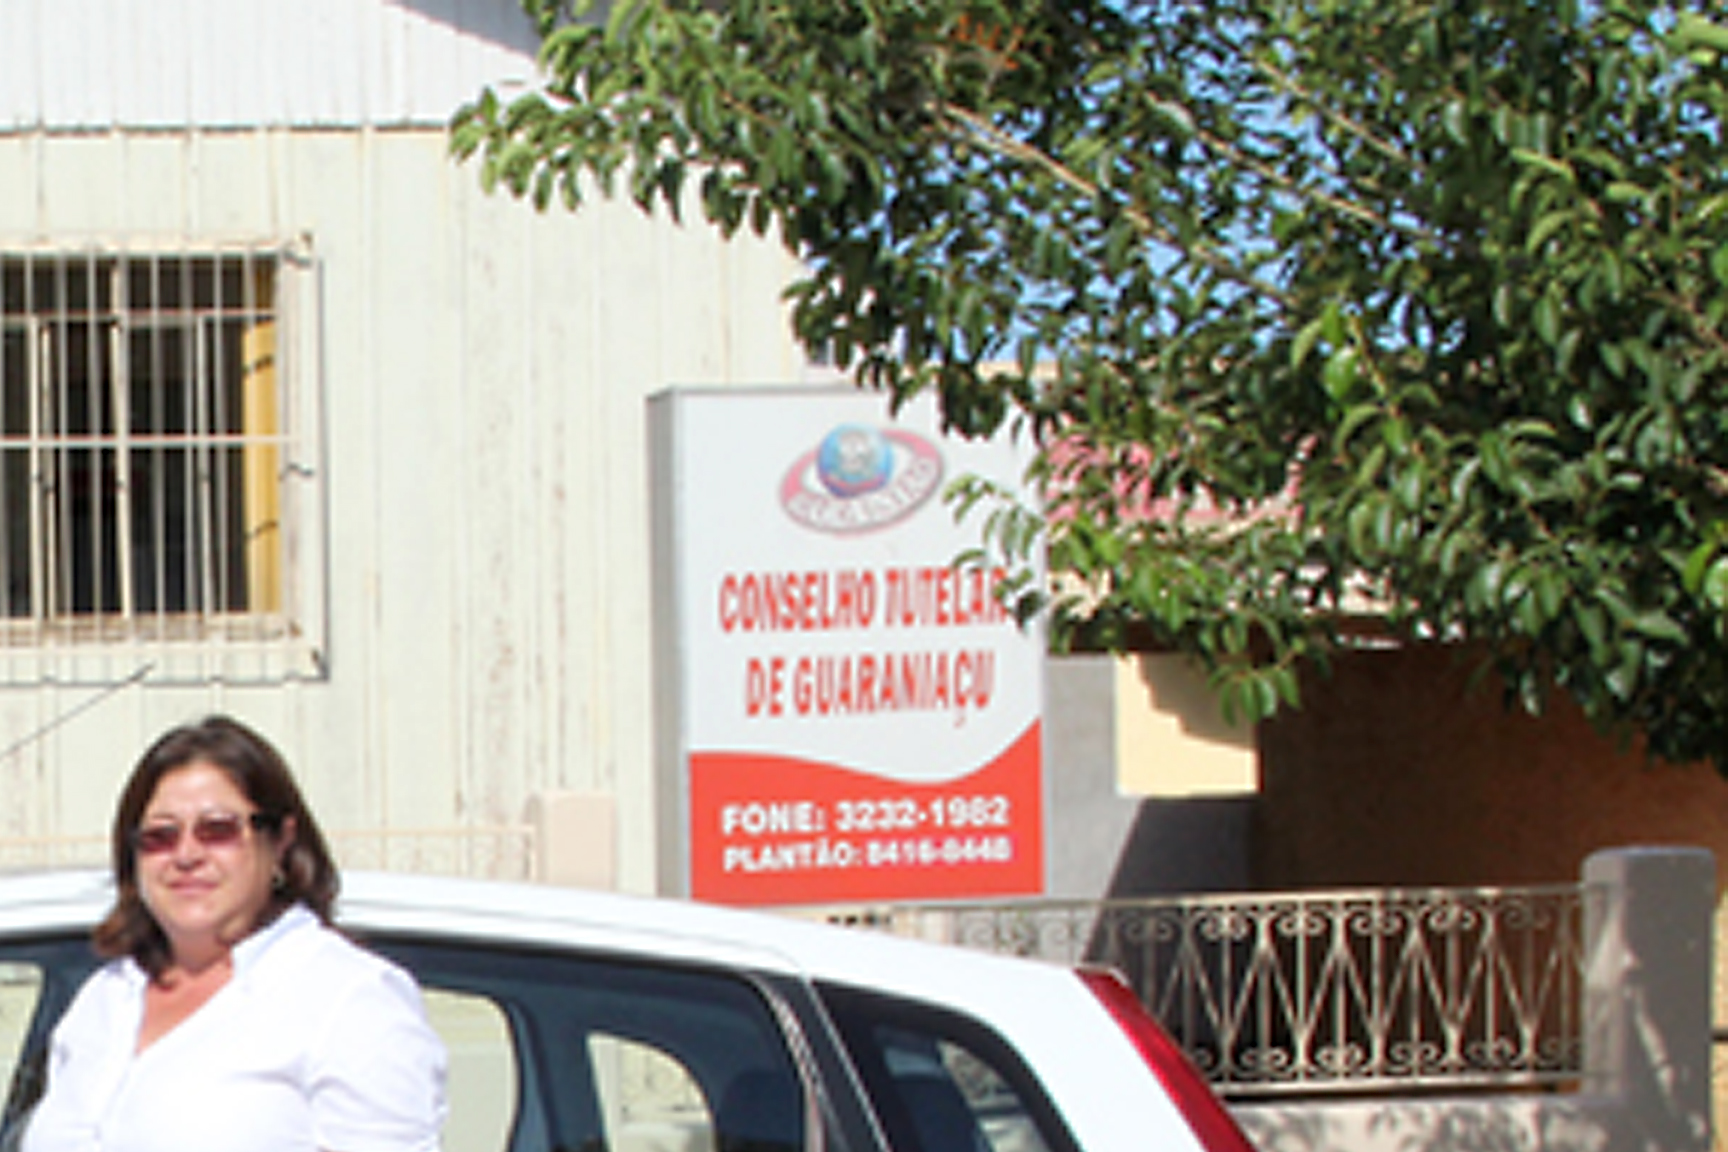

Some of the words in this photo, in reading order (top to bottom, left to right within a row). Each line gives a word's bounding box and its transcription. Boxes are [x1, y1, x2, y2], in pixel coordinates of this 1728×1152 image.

[719, 571, 876, 633] CONSELHO
[884, 567, 1008, 627] TUTELAR
[746, 657, 786, 717] DE
[793, 651, 995, 728] GUARANIAÇU
[721, 801, 826, 836] FONE:
[835, 796, 1010, 831] 3232-1982
[722, 838, 862, 872] PLANTÃO:
